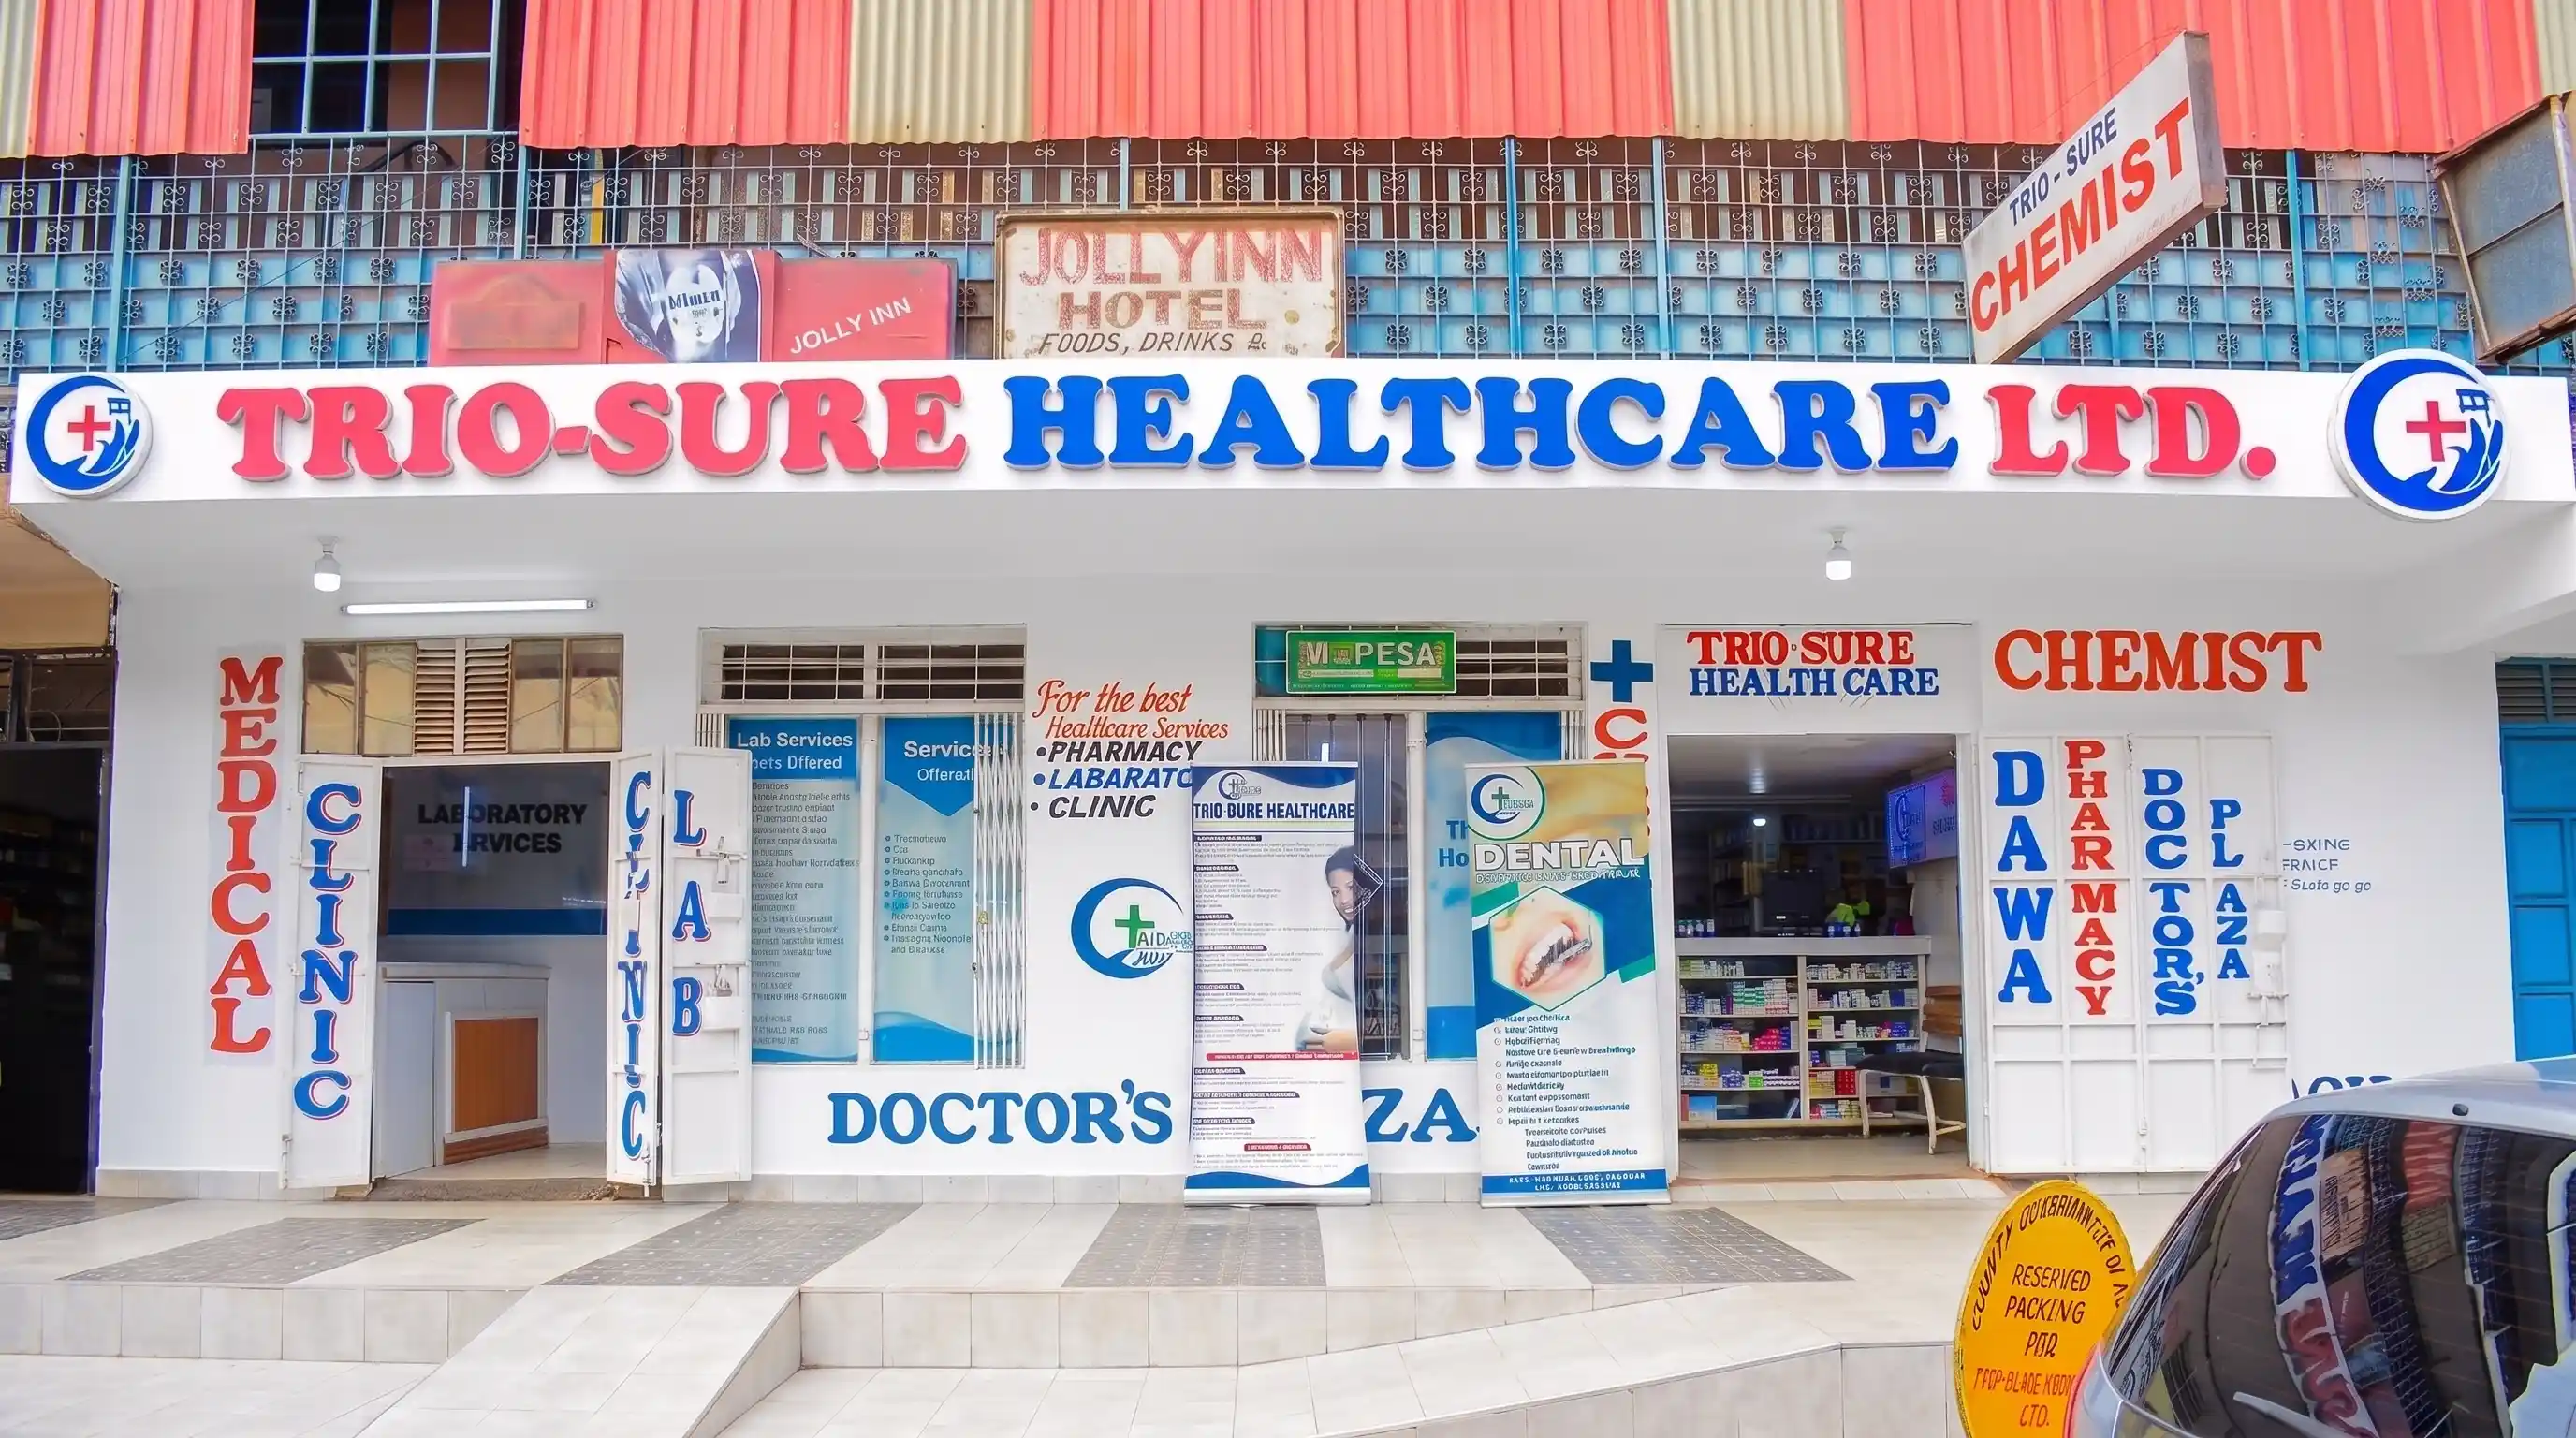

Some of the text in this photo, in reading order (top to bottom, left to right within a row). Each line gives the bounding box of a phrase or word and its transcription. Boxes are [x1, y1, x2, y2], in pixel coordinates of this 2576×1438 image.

[2066, 107, 2117, 177] SURE
[1971, 97, 2189, 332] CHEMIST
[790, 296, 912, 355] JOLLY INN
[1059, 288, 1269, 330] HOTEL
[1039, 332, 1130, 355] FOODS,
[1139, 332, 1234, 352] DRINKS
[217, 374, 2277, 483] TRIO-SURE HEALTHCARE LTD.
[1355, 642, 1436, 666] PESA
[1994, 629, 2322, 693] CHEMIST
[1032, 680, 1192, 718] For the best
[1689, 668, 1939, 697] HEALTH CARE
[737, 732, 853, 747] Lab Services
[1152, 717, 1228, 739] Services
[1048, 741, 1203, 762] PHARMACY
[417, 804, 588, 824] LABORATORY
[1048, 795, 1156, 818] CLINIC
[1266, 802, 1354, 819] HEALTHCARE
[210, 657, 284, 1053] MEDICAL
[1474, 838, 1645, 871] DENTAL
[1992, 750, 2054, 1005] DAWA
[2064, 740, 2118, 1016] PHARMACY
[2209, 799, 2251, 979] PLAZA
[672, 789, 711, 1036] LAB
[293, 783, 361, 1120] CLINIC
[827, 1079, 1173, 1144] DOCTOR'S
[2004, 1295, 2086, 1325] PACKING
